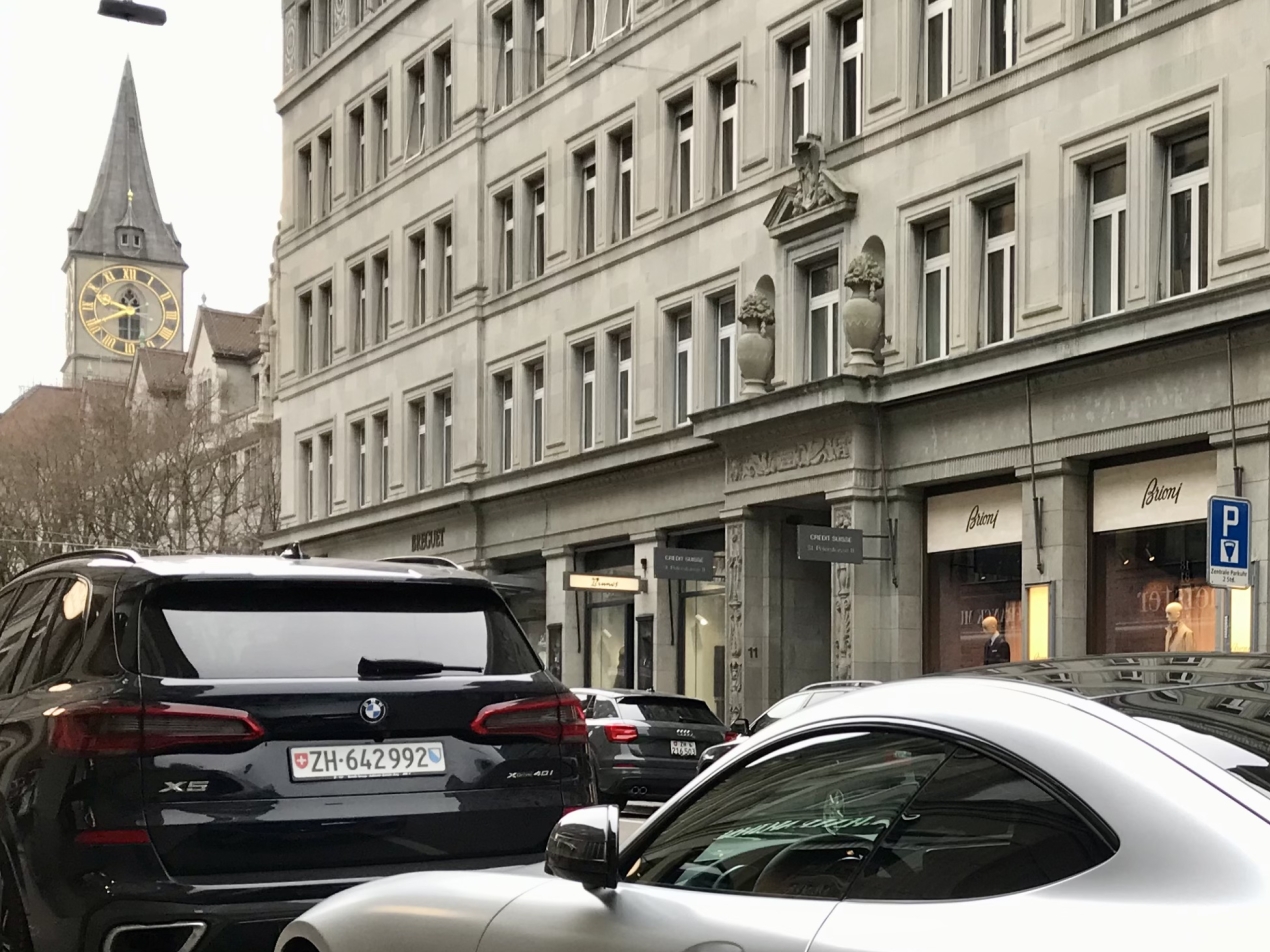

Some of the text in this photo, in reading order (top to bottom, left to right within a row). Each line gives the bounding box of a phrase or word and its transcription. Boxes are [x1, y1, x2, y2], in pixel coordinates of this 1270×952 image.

[1140, 477, 1184, 508] Brioni
[965, 504, 1000, 533] Brioni
[1222, 504, 1240, 537] P
[412, 527, 446, 552] BREGUET
[748, 647, 758, 659] 11
[158, 780, 210, 792] X5
